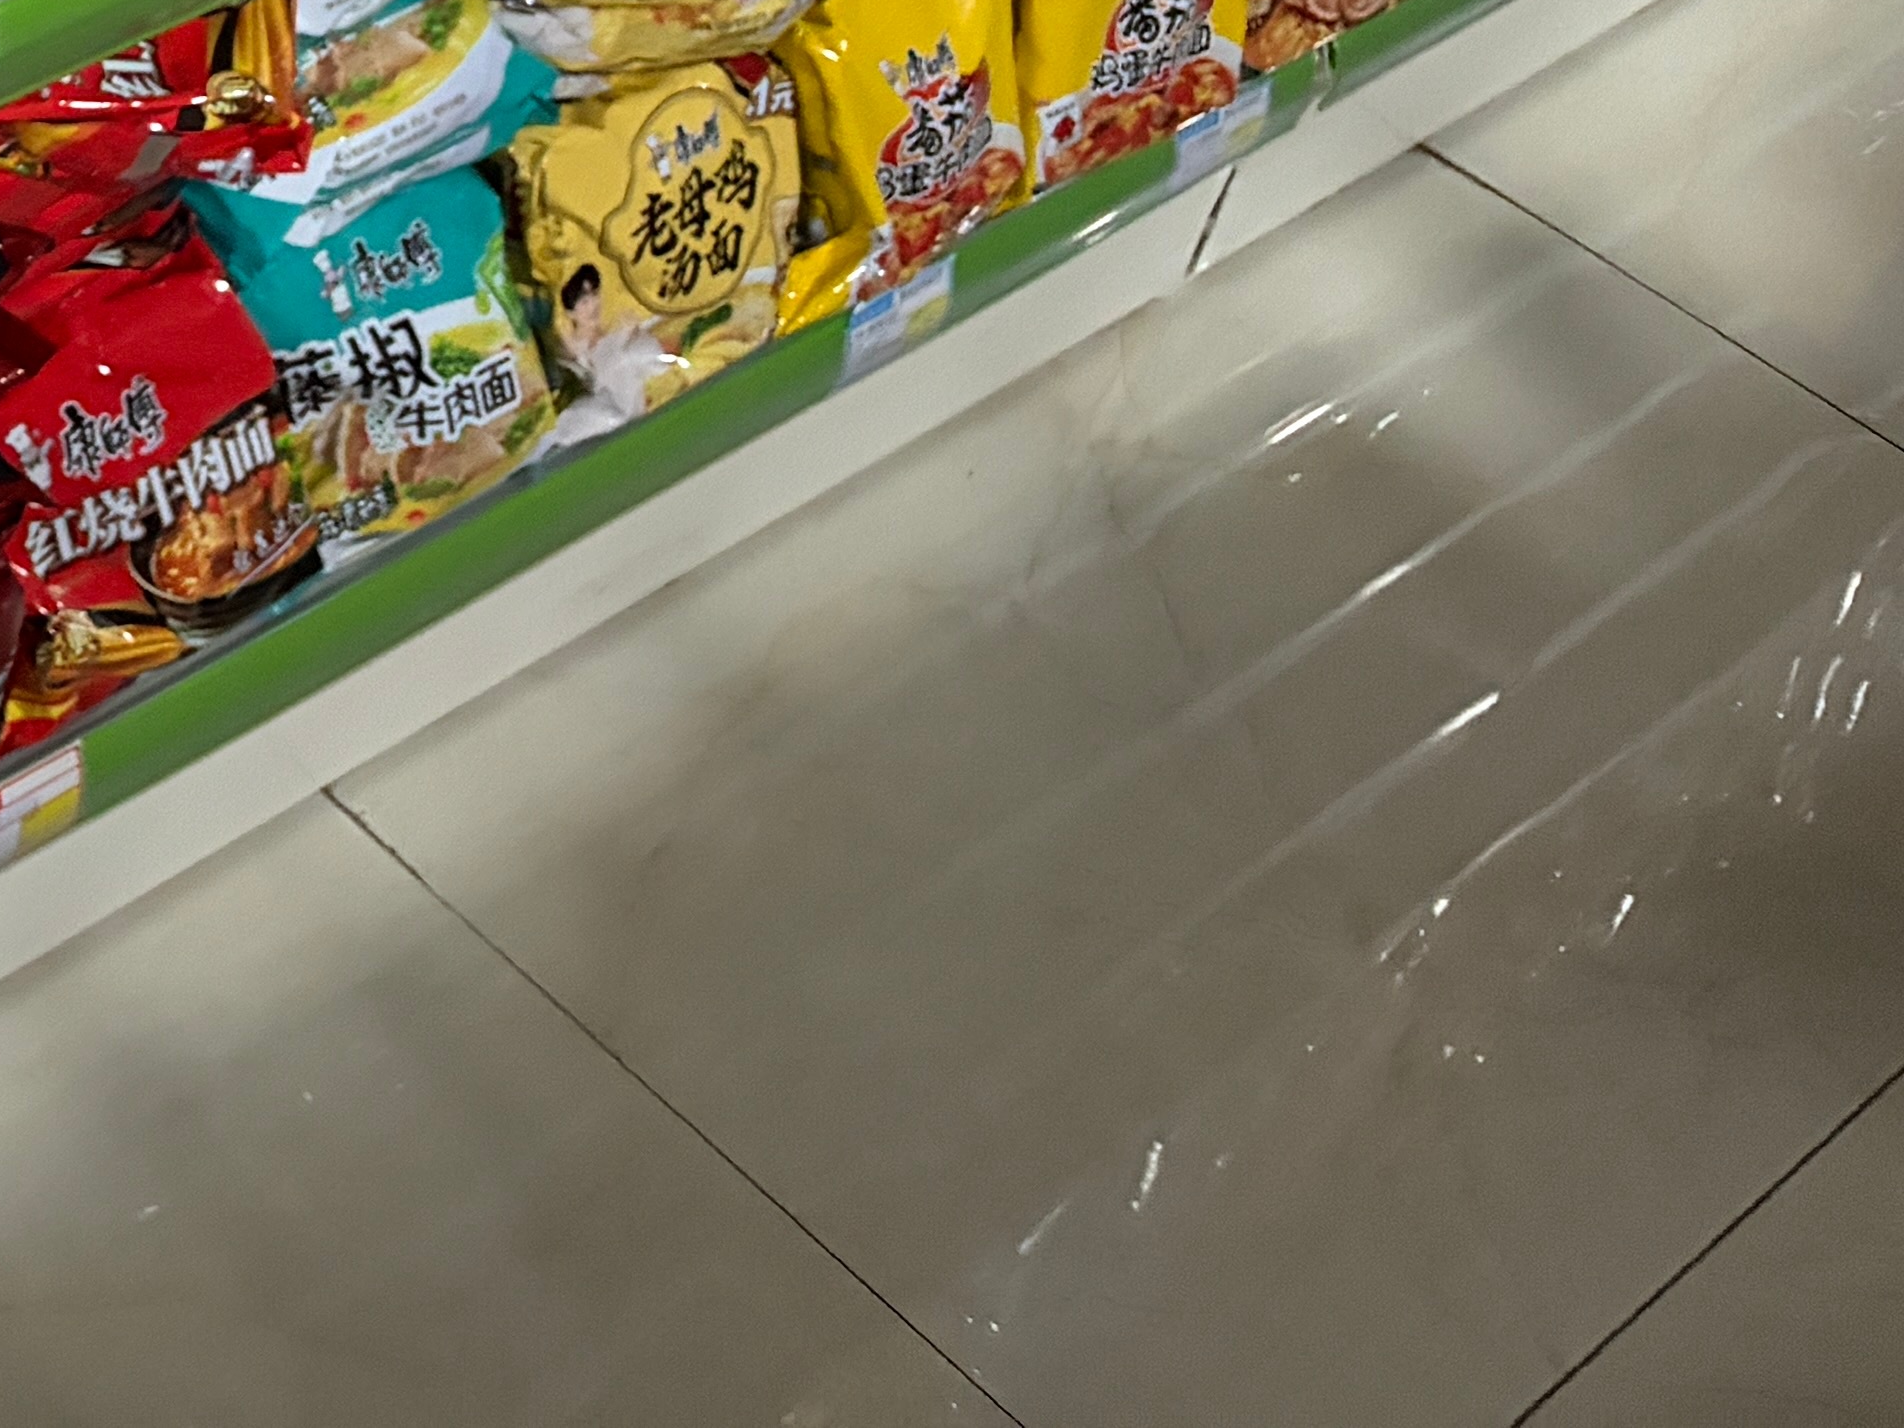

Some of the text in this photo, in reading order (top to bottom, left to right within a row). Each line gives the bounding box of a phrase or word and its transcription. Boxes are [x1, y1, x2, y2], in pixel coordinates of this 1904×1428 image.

[627, 140, 763, 267] 老母鸡
[392, 352, 519, 443] 牛肉面
[23, 405, 278, 578] 红烧牛肉面
